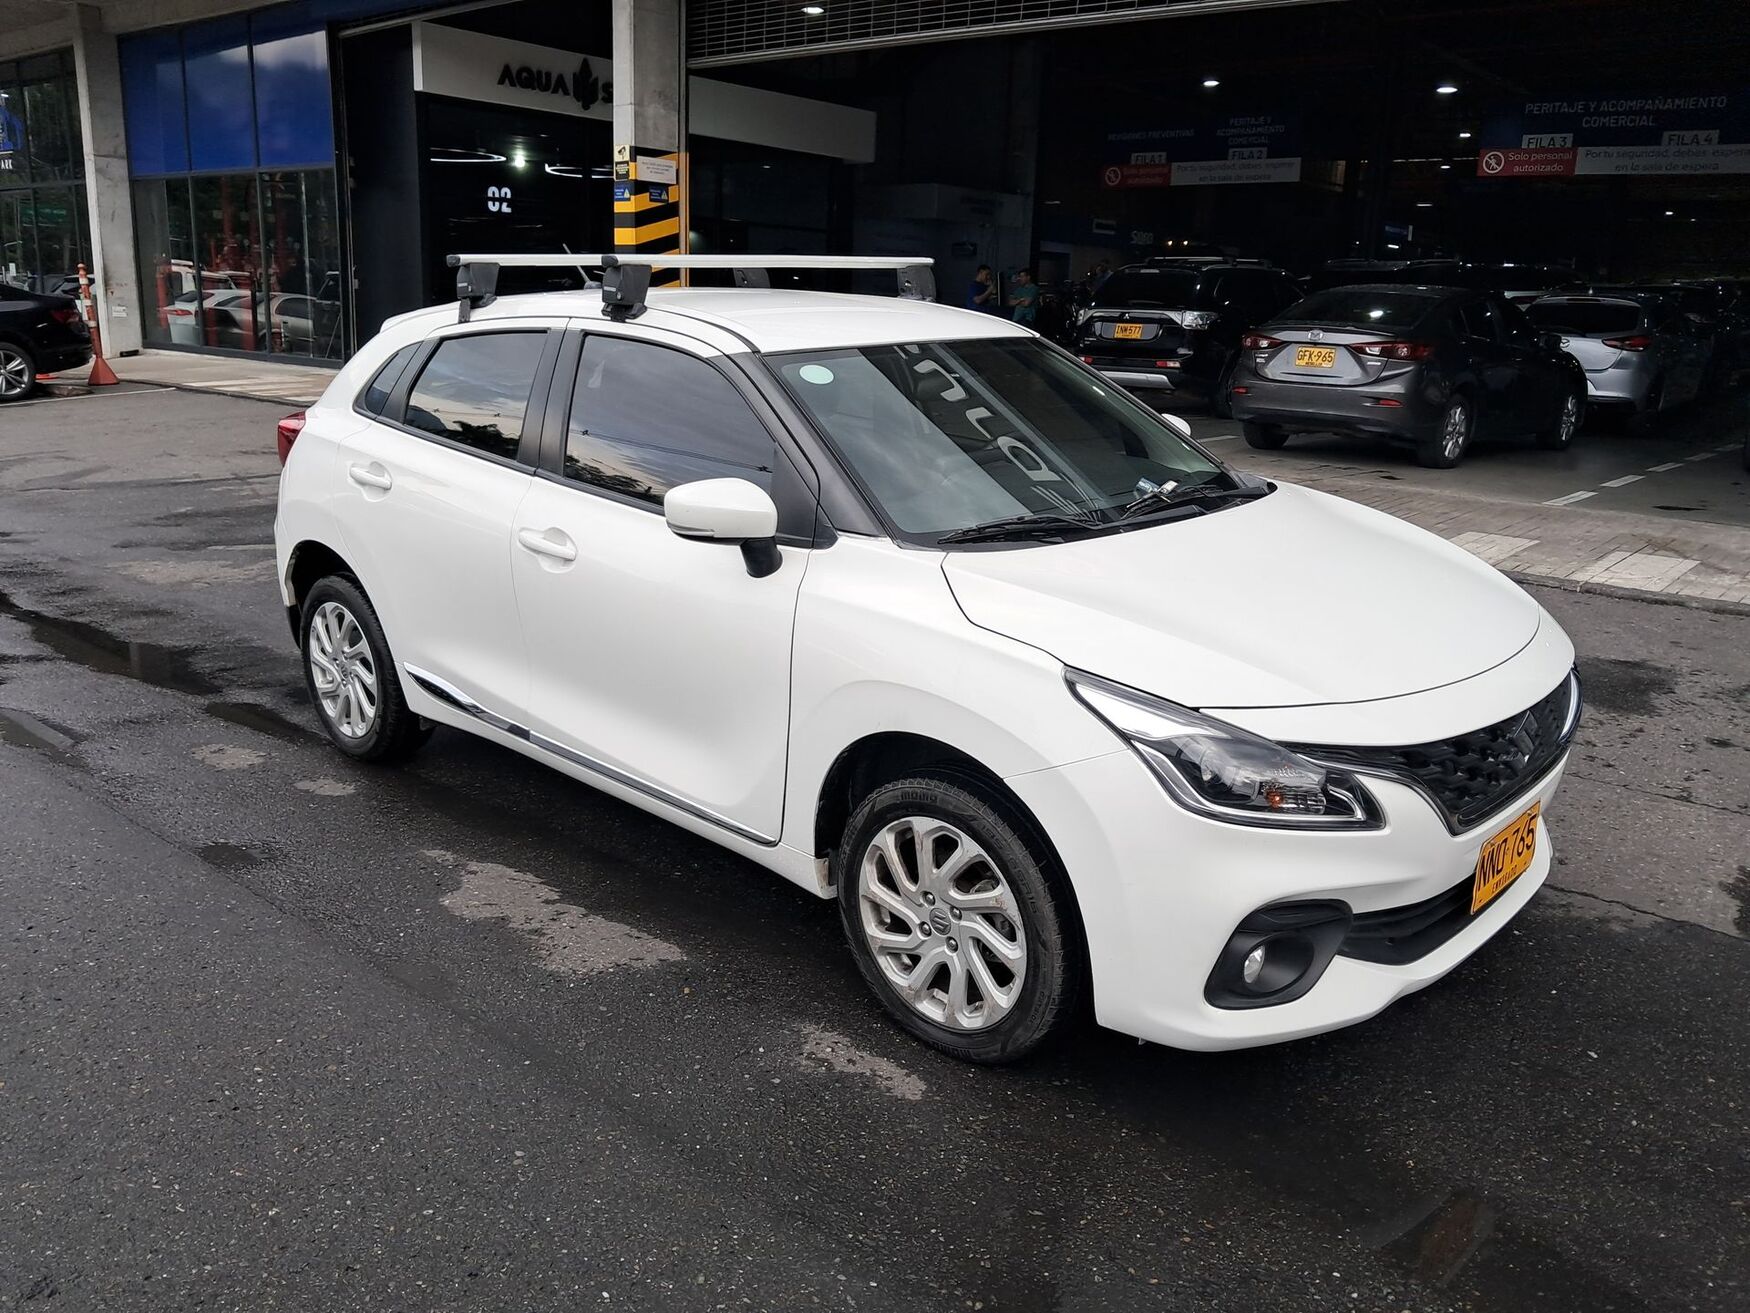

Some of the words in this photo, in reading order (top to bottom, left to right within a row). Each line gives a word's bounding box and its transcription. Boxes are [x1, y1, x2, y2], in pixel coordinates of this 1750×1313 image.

[497, 63, 570, 96] AQUA
[1525, 101, 1585, 114] PERITAJE
[1588, 101, 1597, 112] Y
[1600, 96, 1727, 112] ACOMPAÑAMIENTO
[1582, 115, 1656, 128] COMERCIAL
[1527, 137, 1555, 148] FILA
[1559, 136, 1567, 147] 3
[1668, 134, 1699, 145] FILA
[1704, 133, 1712, 145] 4
[1232, 150, 1255, 160] FILA
[1508, 152, 1529, 161] Solo
[1531, 151, 1572, 163] personal
[1585, 149, 1601, 158] Por
[1513, 163, 1564, 172] autorizado
[487, 186, 513, 213] 02
